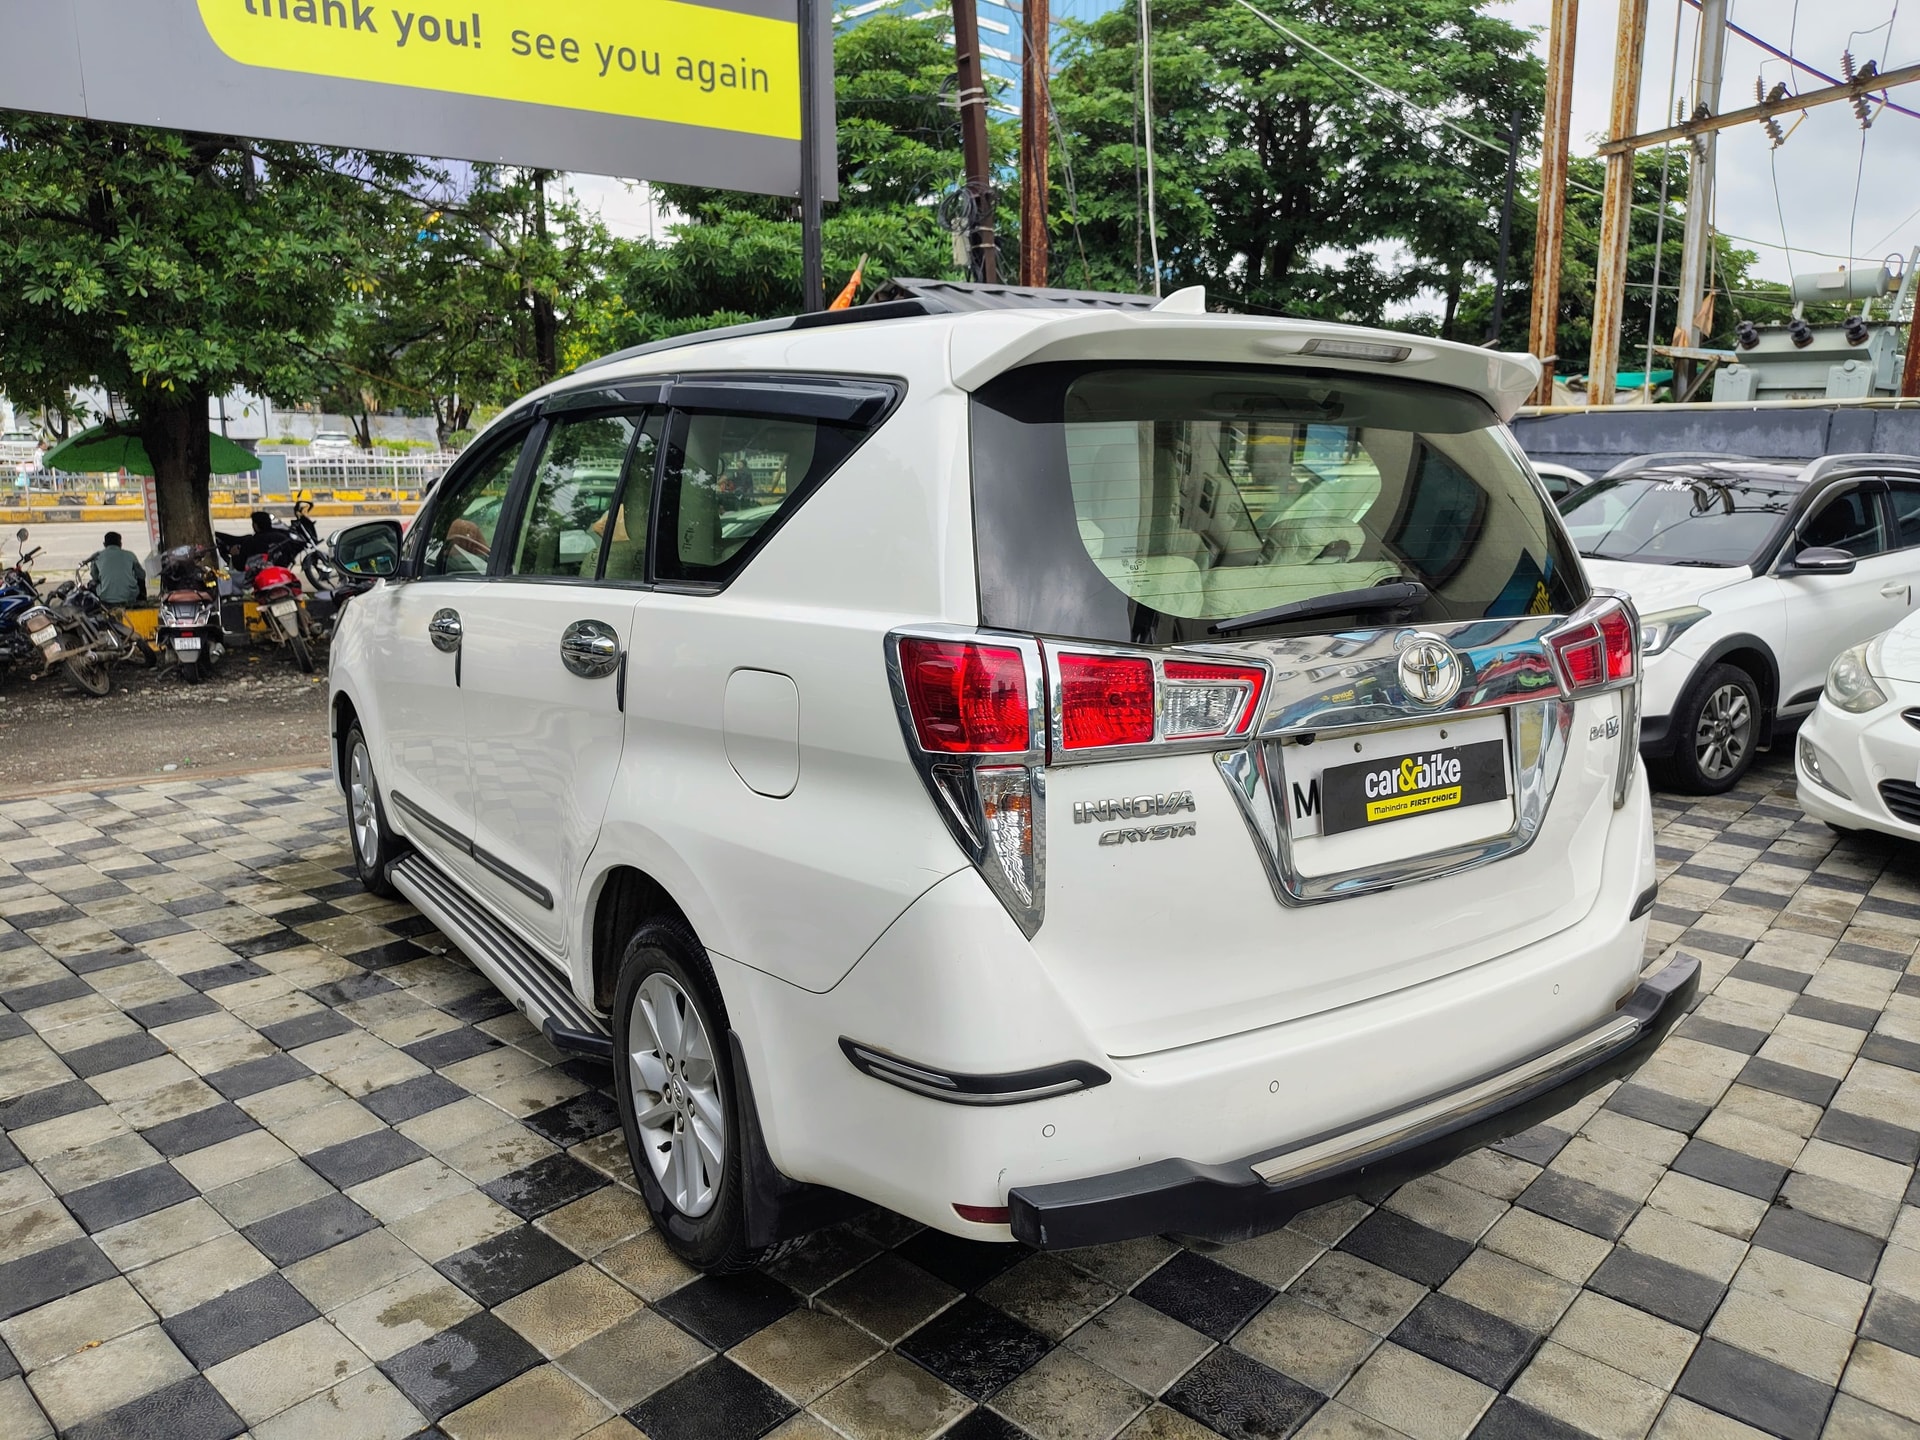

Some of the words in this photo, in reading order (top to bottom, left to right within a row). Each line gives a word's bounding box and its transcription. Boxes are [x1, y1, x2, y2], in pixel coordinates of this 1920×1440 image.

[391, 10, 481, 49] you!
[511, 29, 580, 63] see
[594, 42, 661, 77] you
[675, 54, 769, 93] again
[1365, 753, 1461, 798] car&bike
[1073, 790, 1197, 824] INNOVA
[1292, 779, 1321, 819] M
[1374, 803, 1408, 815] Mahindra
[1410, 797, 1431, 808] FIRST
[1431, 792, 1458, 803] CHOICE
[1098, 821, 1197, 846] CRYSTA
